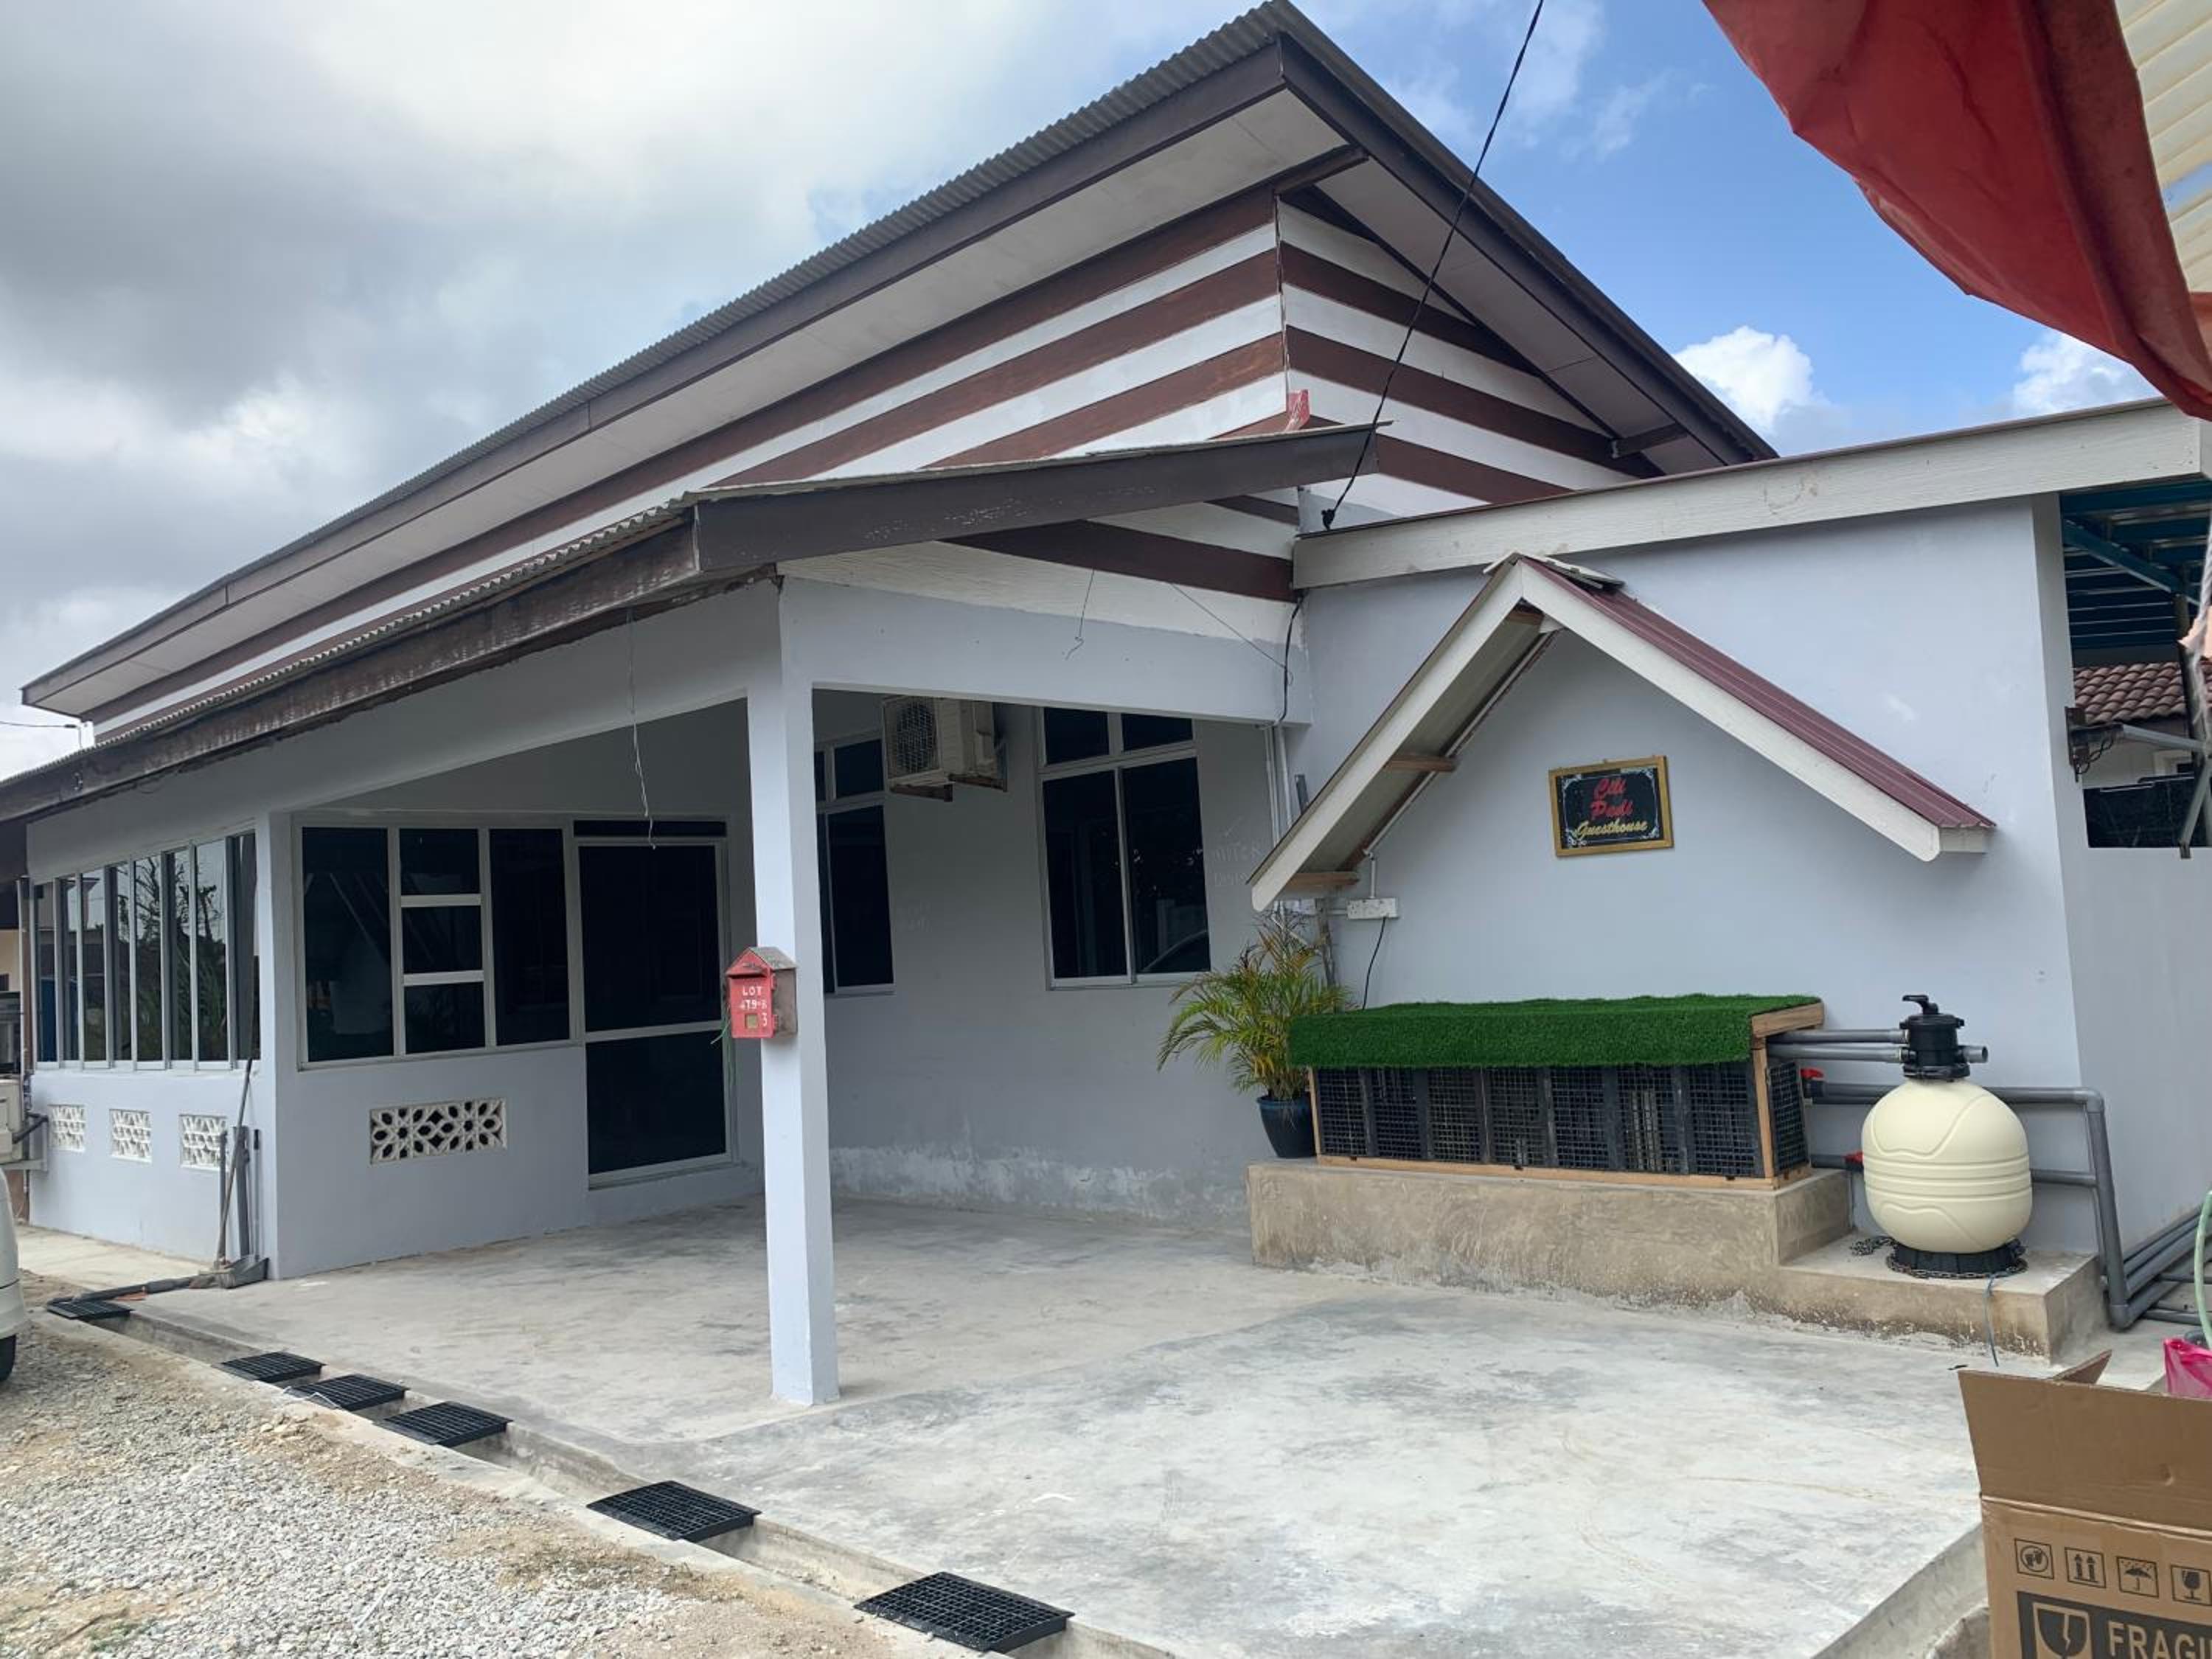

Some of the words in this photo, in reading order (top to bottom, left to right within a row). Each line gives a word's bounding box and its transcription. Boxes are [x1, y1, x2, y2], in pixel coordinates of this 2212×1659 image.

[1574, 818, 1648, 840] Guesthouse
[742, 986, 762, 996] LOT
[762, 1012, 768, 1026] 3
[2108, 1620, 2212, 1659] FRAGI
